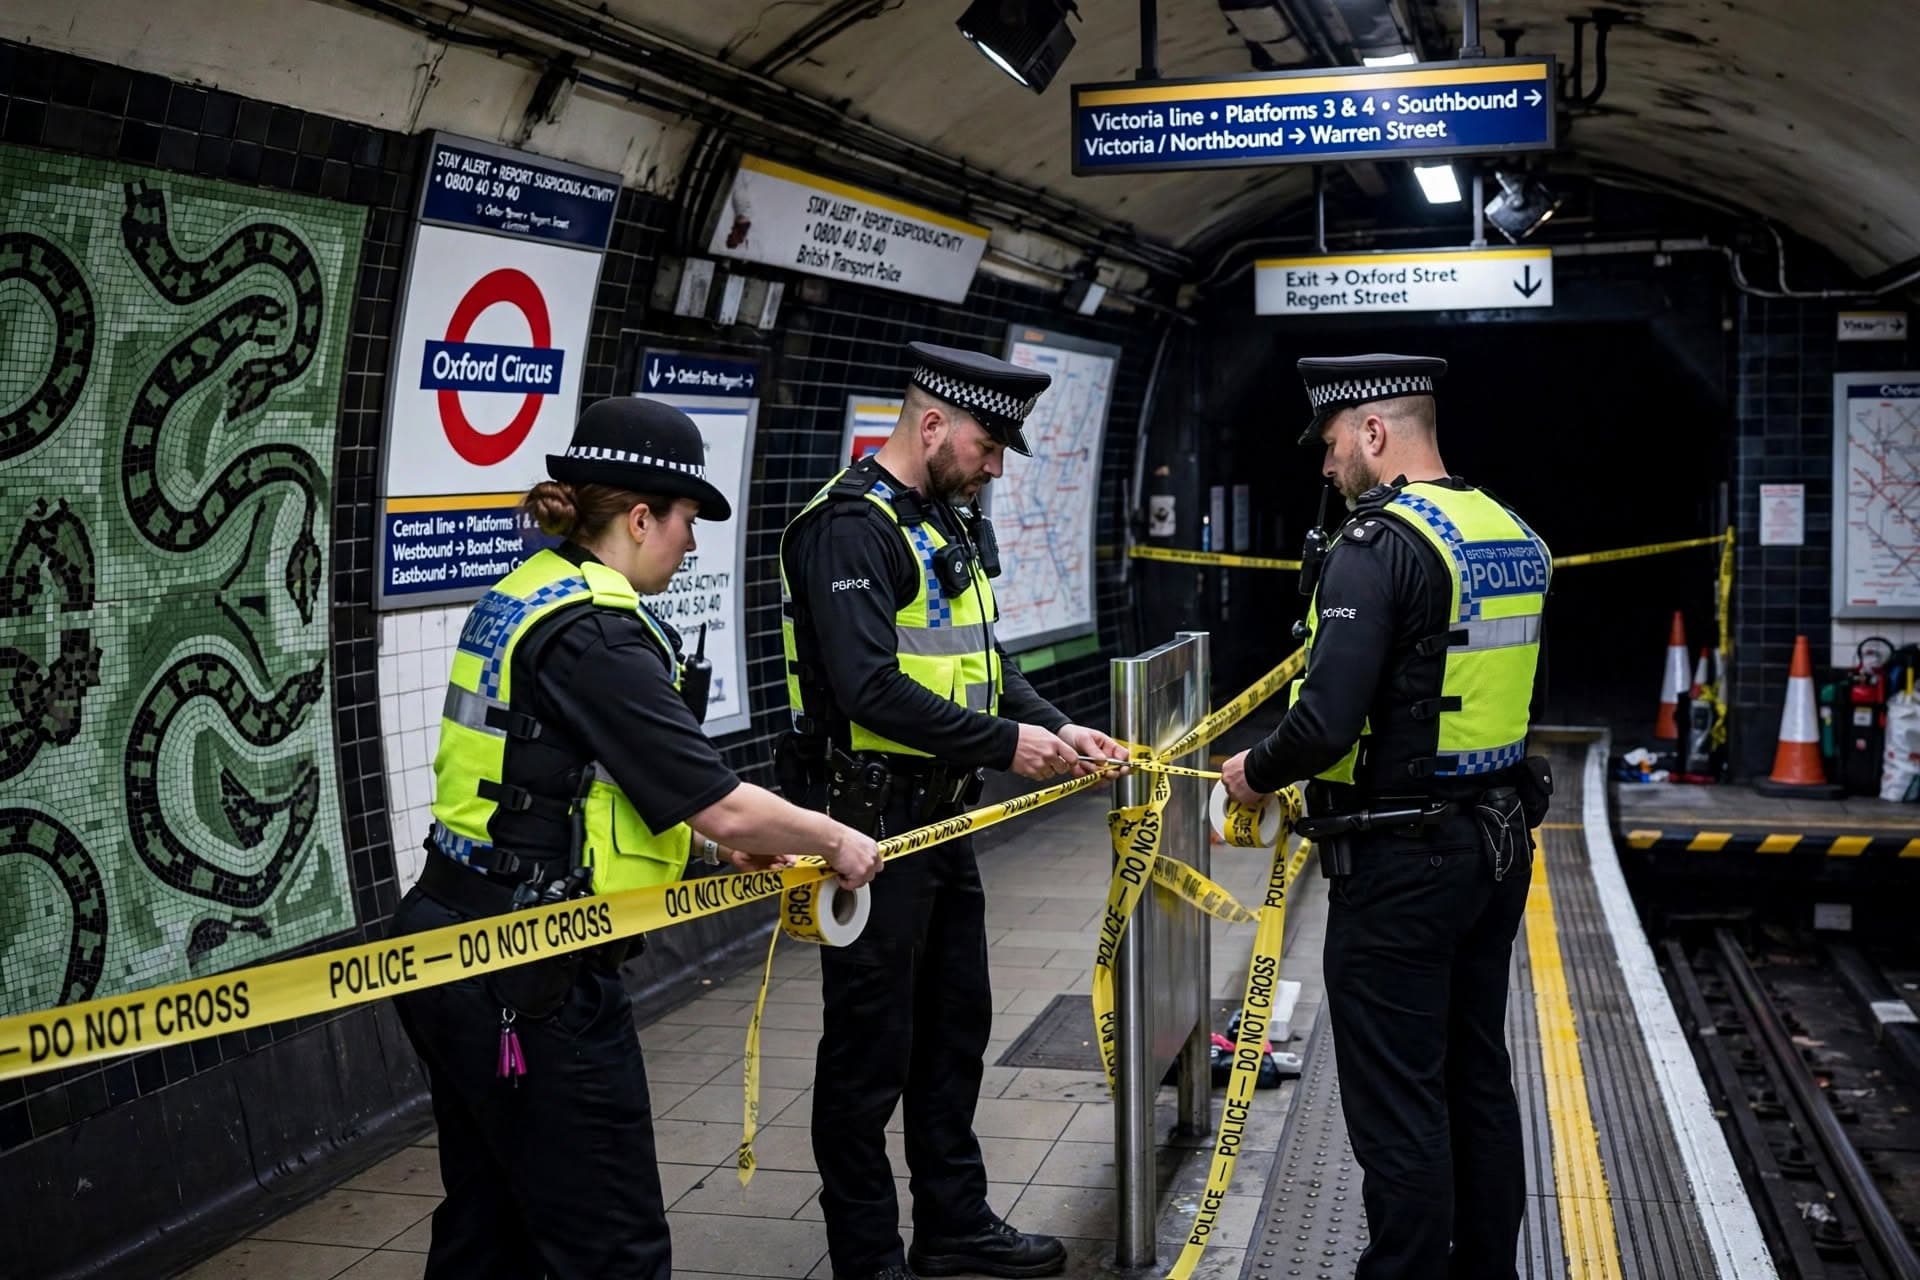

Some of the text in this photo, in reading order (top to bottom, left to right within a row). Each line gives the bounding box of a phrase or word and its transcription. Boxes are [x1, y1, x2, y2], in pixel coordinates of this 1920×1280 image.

[1092, 89, 1517, 132] Victoria line Platforms 3 & 4 Southbound
[1085, 135, 1154, 157] Victoria
[1170, 127, 1283, 152] Northbound
[1310, 124, 1381, 146] Warren
[1386, 119, 1447, 140] Street
[437, 151, 461, 169] STAY
[461, 156, 492, 176] ALERT
[499, 164, 534, 185] REPORT
[444, 172, 521, 201] 0800 40 50 40
[806, 195, 830, 215] STAY
[829, 203, 857, 222] ALERT
[813, 222, 888, 257] 0800 40 50 40
[796, 244, 902, 283] British Transport Police
[1287, 267, 1459, 287] Exit Oxford Stret
[1286, 288, 1408, 310] Regent Street
[432, 351, 553, 384] Oxford Circus
[392, 518, 434, 537] Central
[436, 516, 455, 534] line
[466, 515, 513, 533] Platforms
[392, 537, 523, 561] Westbound Bond Street
[392, 563, 447, 585] Eastbound
[460, 559, 510, 578] Tottenham
[1471, 559, 1545, 590] POLICE
[677, 598, 690, 616] 40
[693, 595, 706, 615] 50
[708, 593, 722, 612] 40
[1097, 904, 1126, 969] POLICE
[1119, 857, 1146, 885] DO
[31, 869, 784, 1063] DO NOT CROSS POLICE DO NOT CROSS DO NOT CROSS
[1251, 955, 1277, 1007] CROSS
[1243, 1011, 1266, 1045] NOT
[1237, 1045, 1257, 1072] DO
[1219, 1098, 1250, 1157] POLICE
[1190, 1188, 1225, 1246] POLICE
